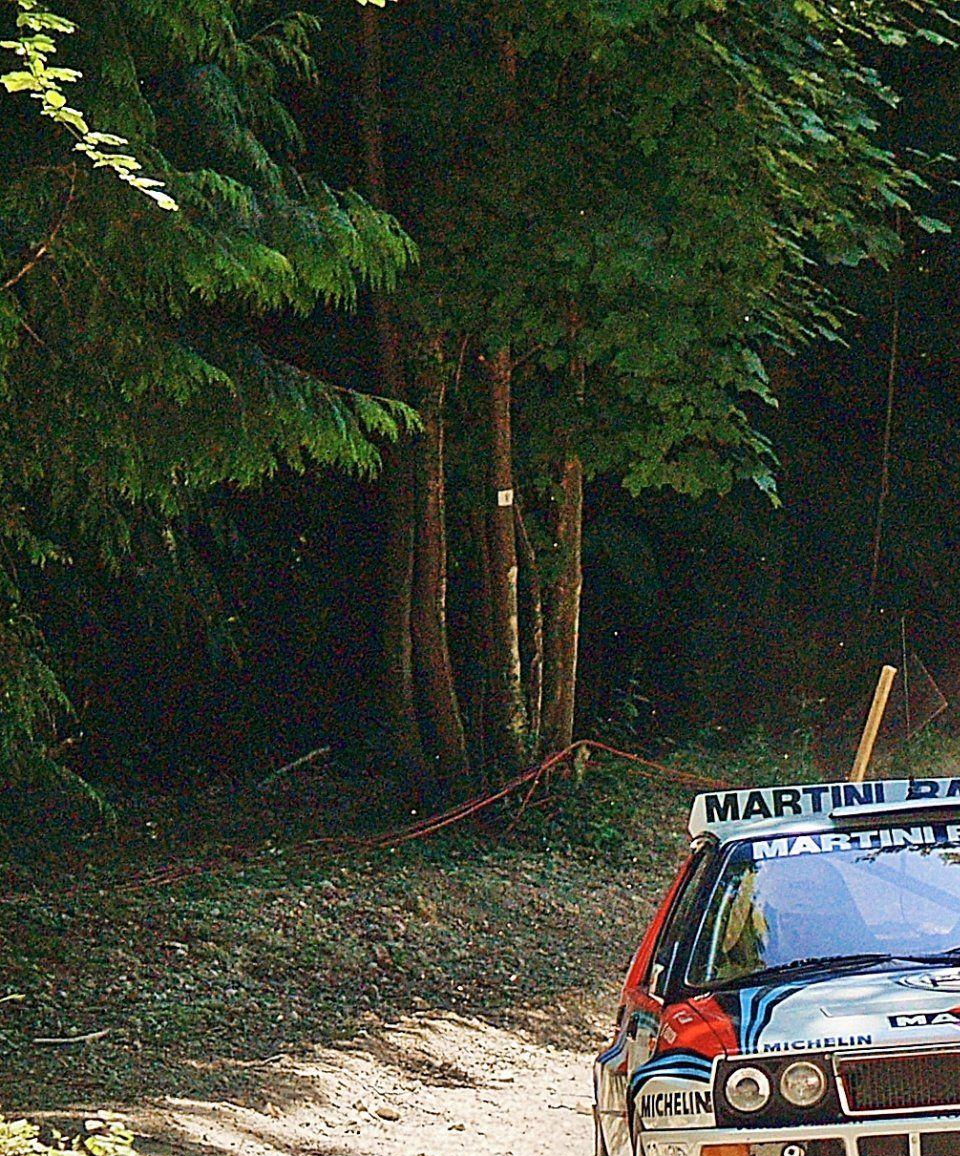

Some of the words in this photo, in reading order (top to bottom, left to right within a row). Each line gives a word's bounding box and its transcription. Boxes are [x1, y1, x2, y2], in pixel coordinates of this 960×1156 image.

[705, 782, 886, 823] MARTINI
[752, 825, 936, 860] MARTINI
[763, 1035, 873, 1053] MICHELIN
[641, 1090, 713, 1118] MICHELIN
